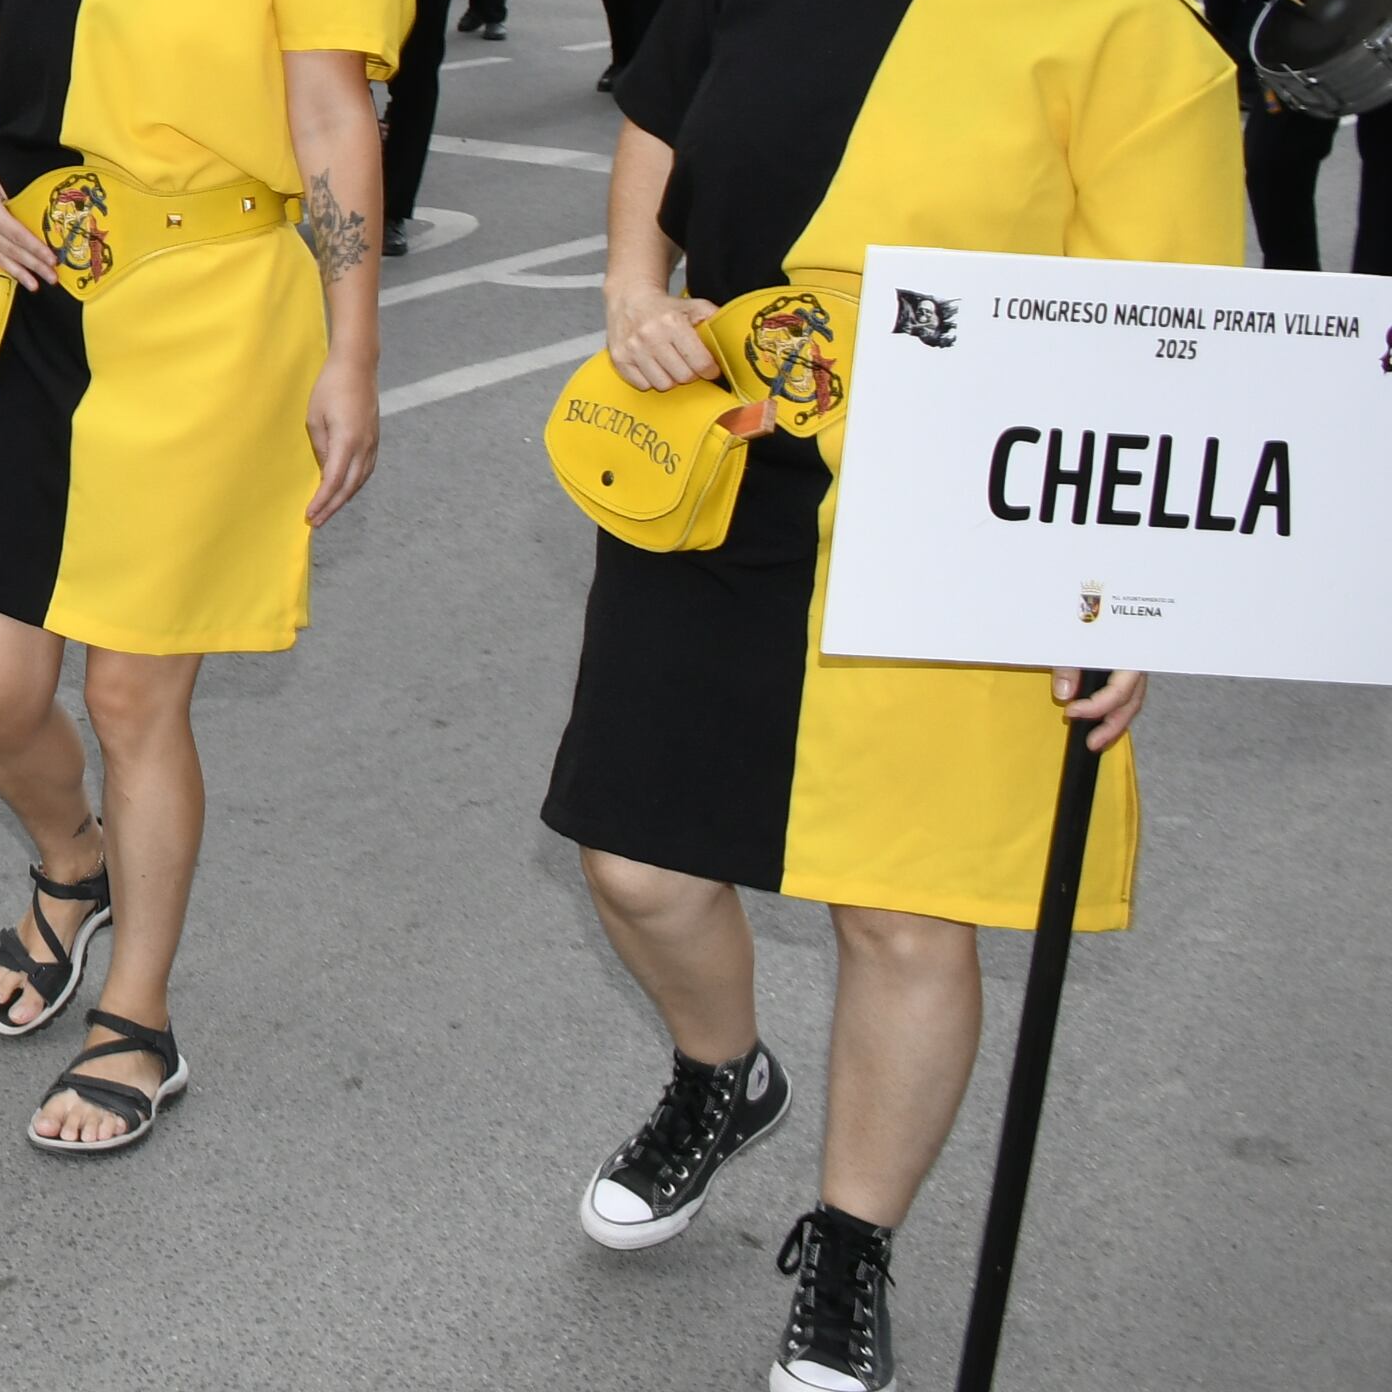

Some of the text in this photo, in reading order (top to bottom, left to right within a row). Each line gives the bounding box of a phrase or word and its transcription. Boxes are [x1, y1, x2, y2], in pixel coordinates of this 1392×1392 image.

[992, 297, 1360, 338] I CONGRESO NACIONAL PIRATA VILLENA
[1155, 338, 1198, 360] 2025
[563, 399, 682, 476] BUCANEROS
[987, 425, 1292, 537] CHELLA
[1111, 604, 1162, 618] VILLENA
